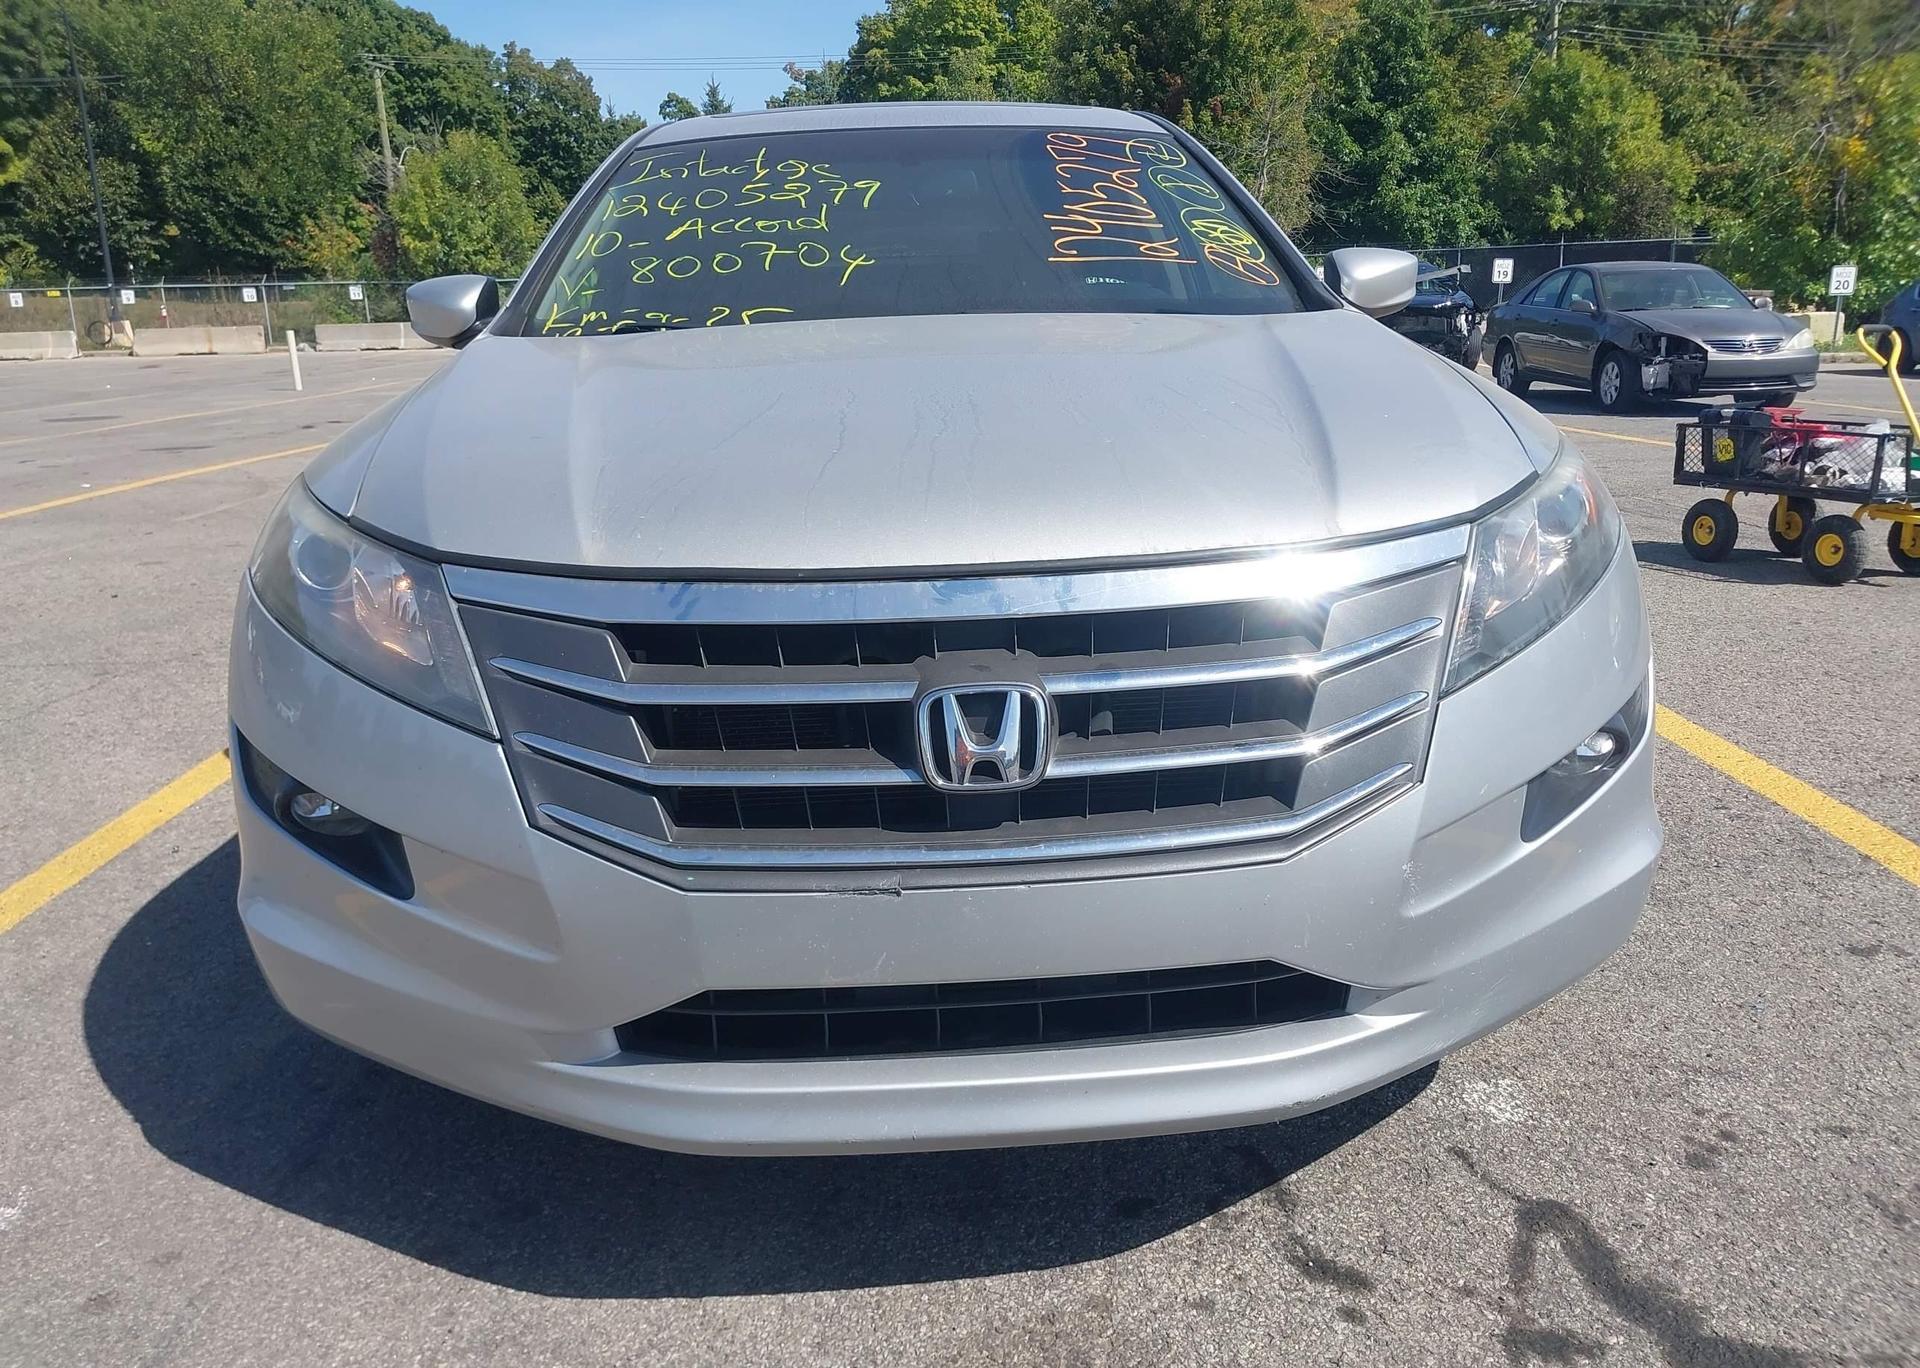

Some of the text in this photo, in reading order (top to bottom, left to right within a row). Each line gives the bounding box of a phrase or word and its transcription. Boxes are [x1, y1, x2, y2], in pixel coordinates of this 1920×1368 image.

[664, 203, 830, 241] Accord
[629, 241, 876, 286] 800704
[1497, 270, 1509, 280] 19
[1834, 280, 1850, 290] 20
